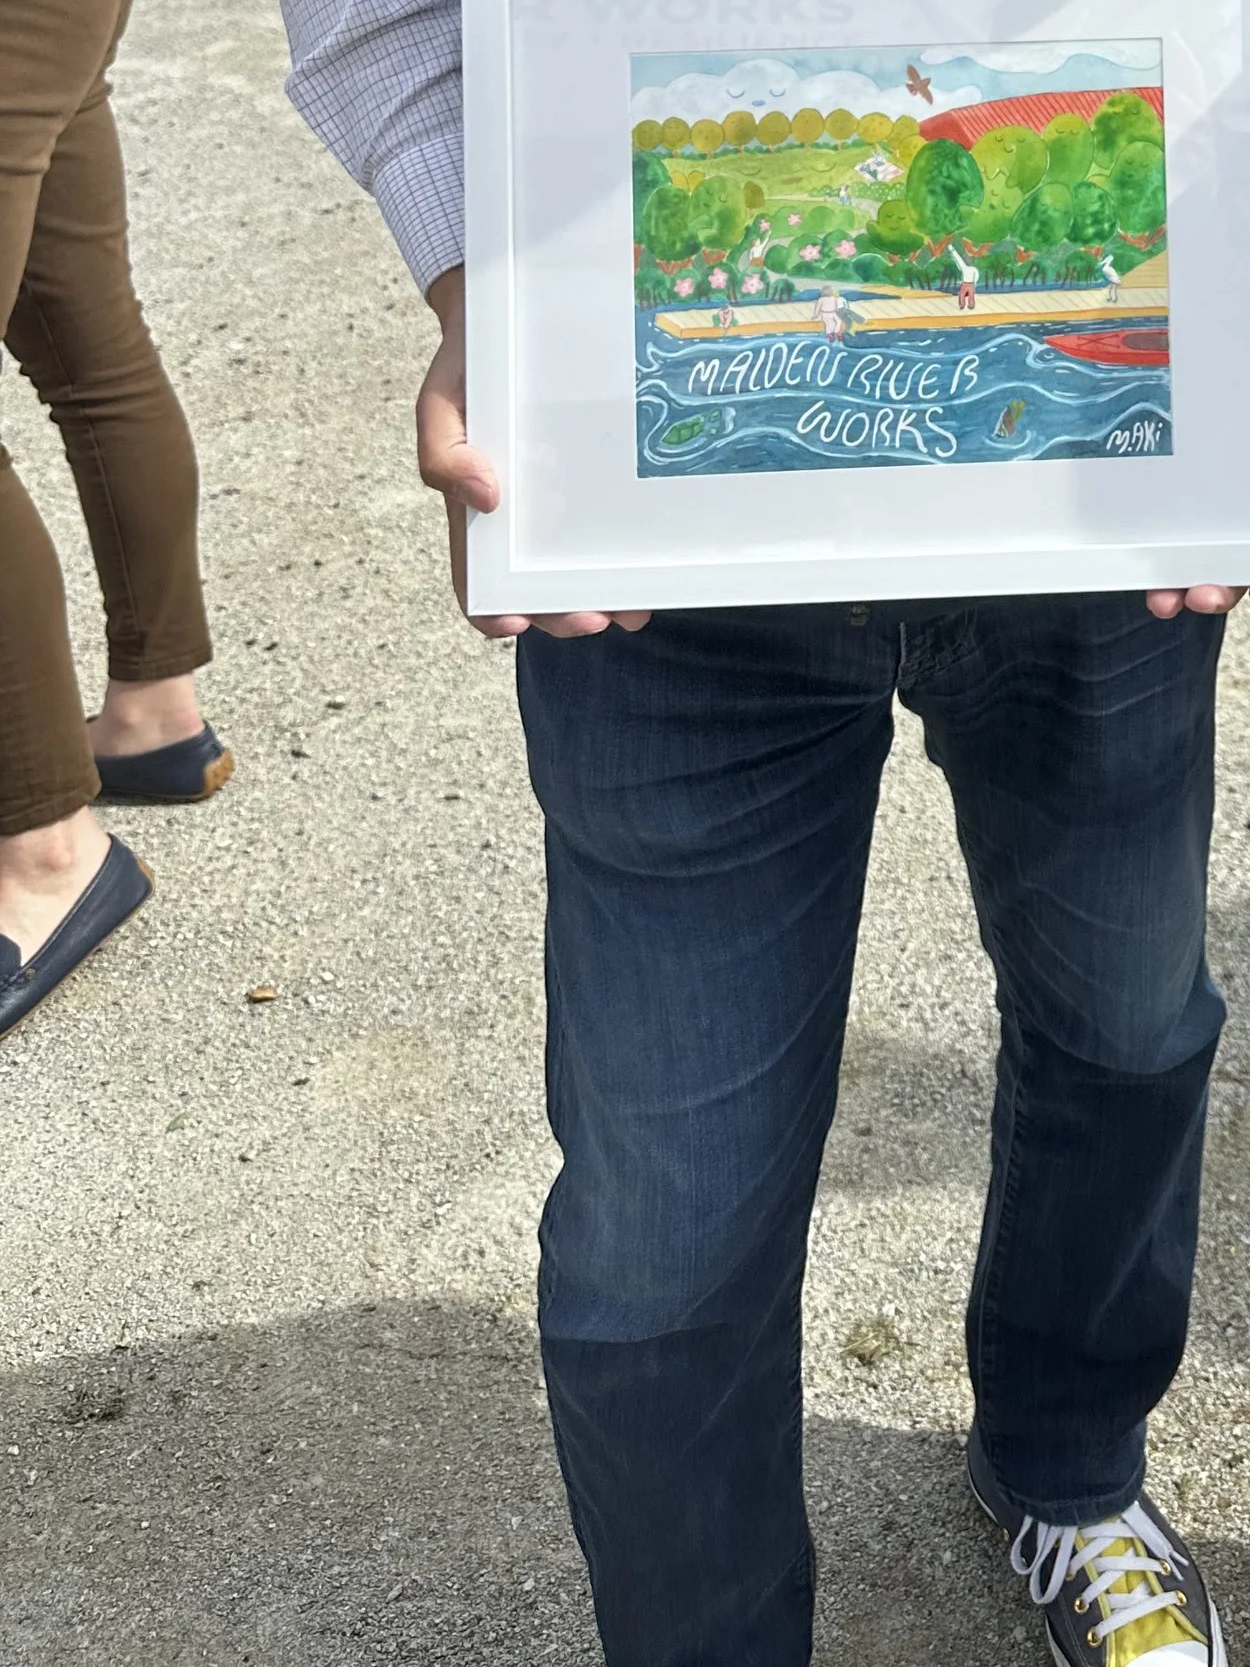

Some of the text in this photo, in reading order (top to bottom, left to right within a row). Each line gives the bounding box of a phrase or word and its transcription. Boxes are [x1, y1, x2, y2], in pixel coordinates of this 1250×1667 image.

[688, 341, 980, 401] MALDEN RIVER
[797, 400, 957, 457] WORKS
